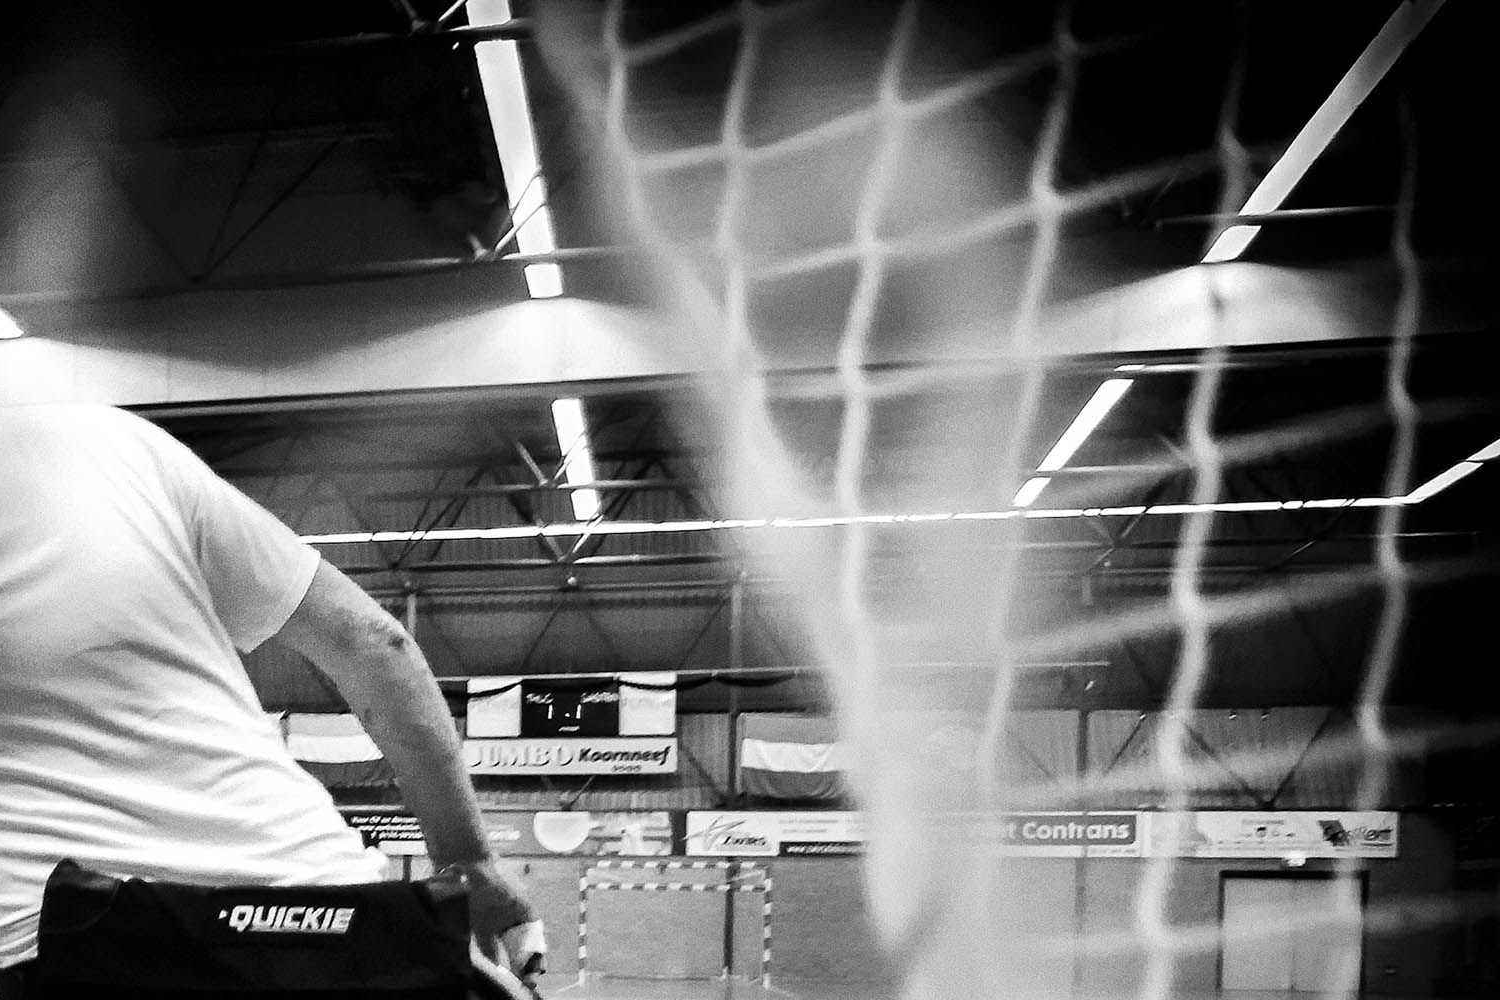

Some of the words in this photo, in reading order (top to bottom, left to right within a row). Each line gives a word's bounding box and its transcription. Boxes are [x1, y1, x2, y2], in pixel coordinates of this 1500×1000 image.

[578, 746, 672, 766] Koornneef
[1022, 822, 1130, 840] Contrans
[228, 904, 355, 933] QUICKIE
